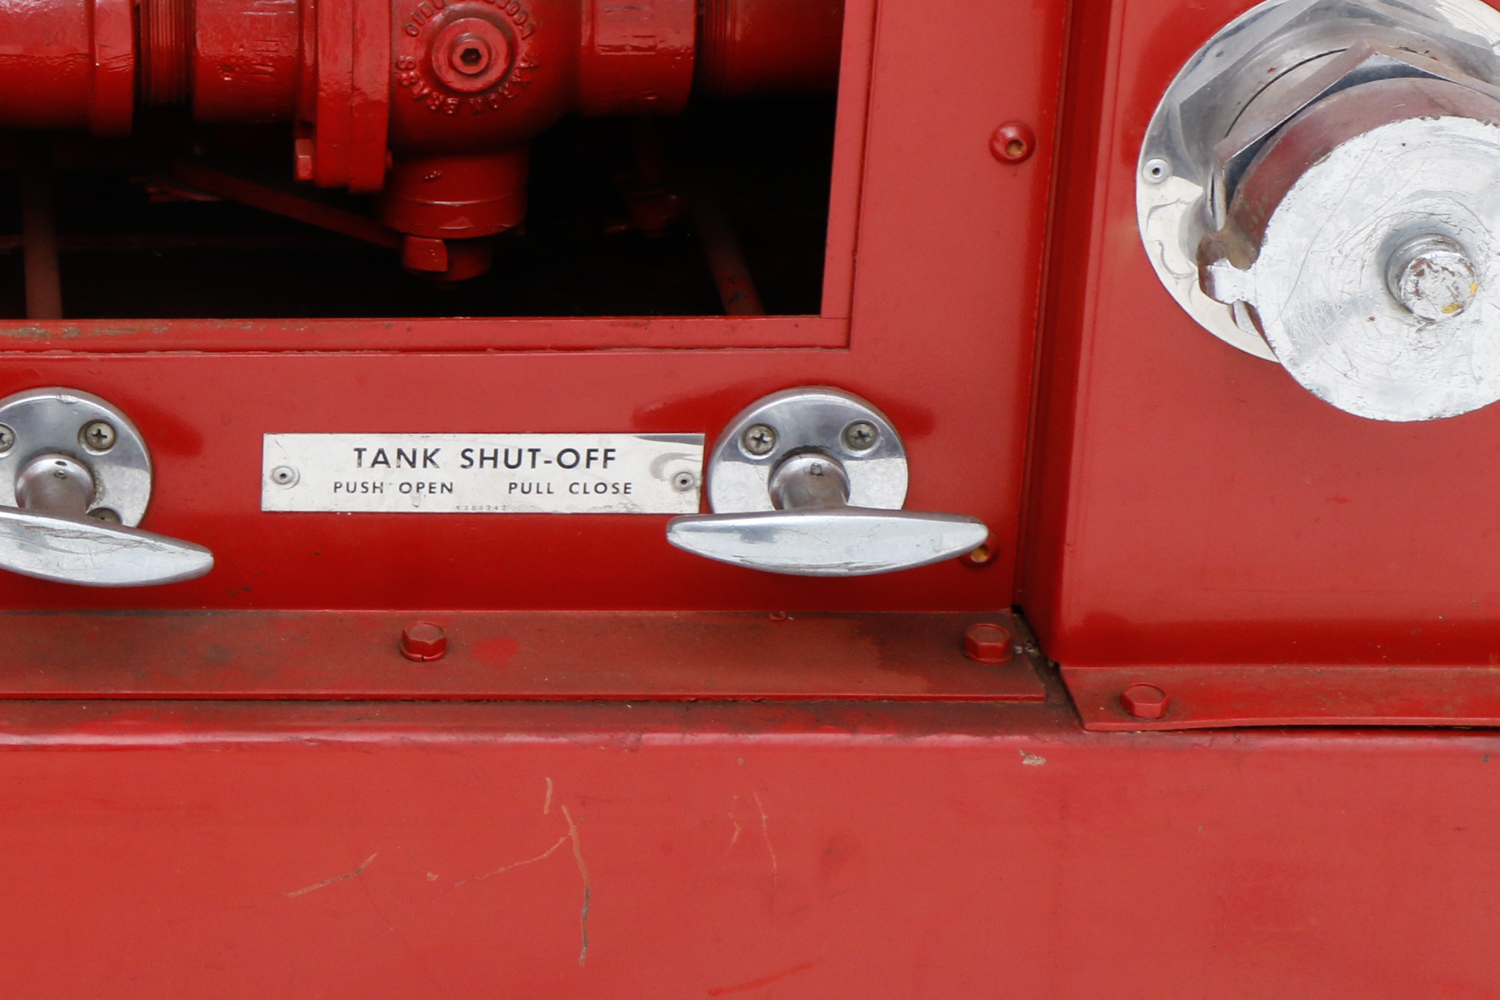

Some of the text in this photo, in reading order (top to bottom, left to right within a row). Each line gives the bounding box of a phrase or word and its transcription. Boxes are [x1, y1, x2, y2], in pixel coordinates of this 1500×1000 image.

[354, 448, 616, 469] TANK SHUT-OFF
[333, 481, 454, 494] PUSH OPEN
[509, 482, 631, 494] PULL CLOSE
